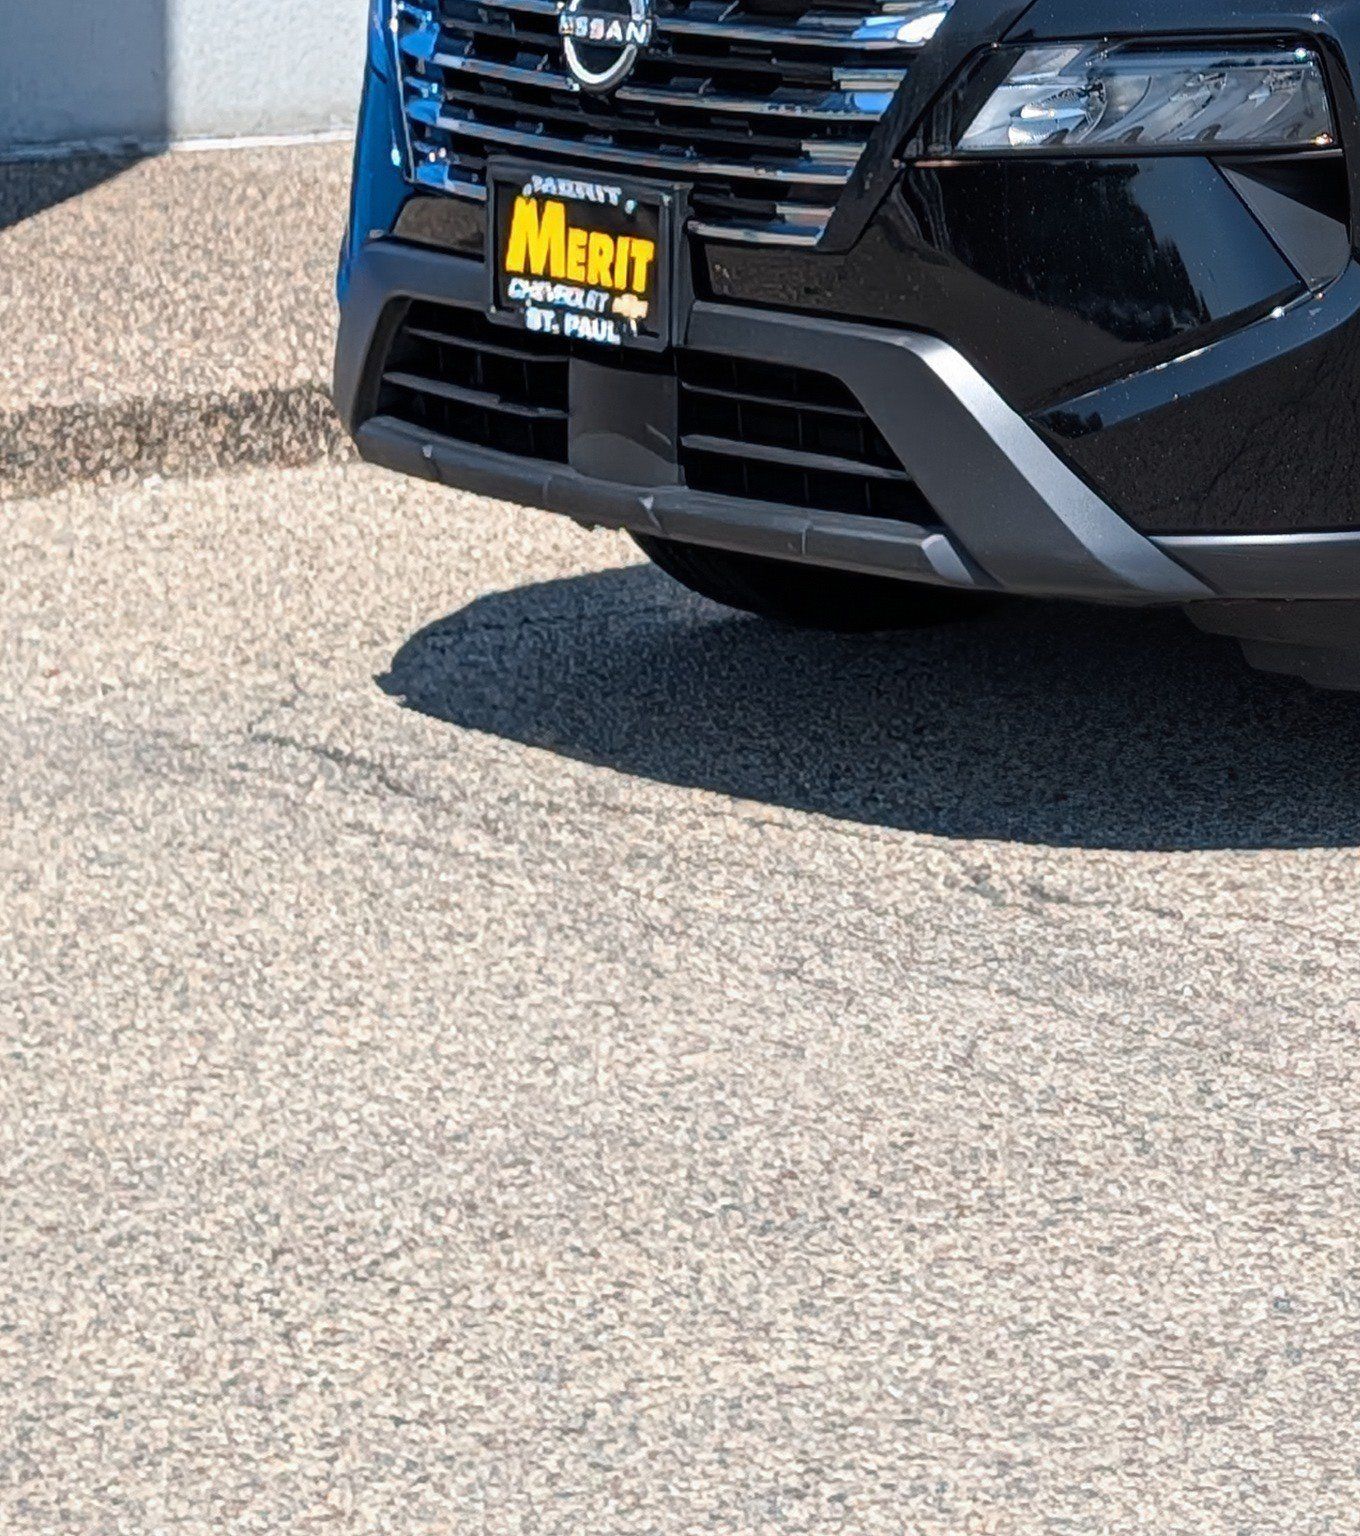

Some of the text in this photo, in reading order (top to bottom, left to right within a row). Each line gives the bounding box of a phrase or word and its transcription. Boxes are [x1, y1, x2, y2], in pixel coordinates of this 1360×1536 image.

[558, 13, 653, 46] NISSAN
[505, 195, 656, 293] MERIT
[525, 306, 621, 345] ST. PAUL
